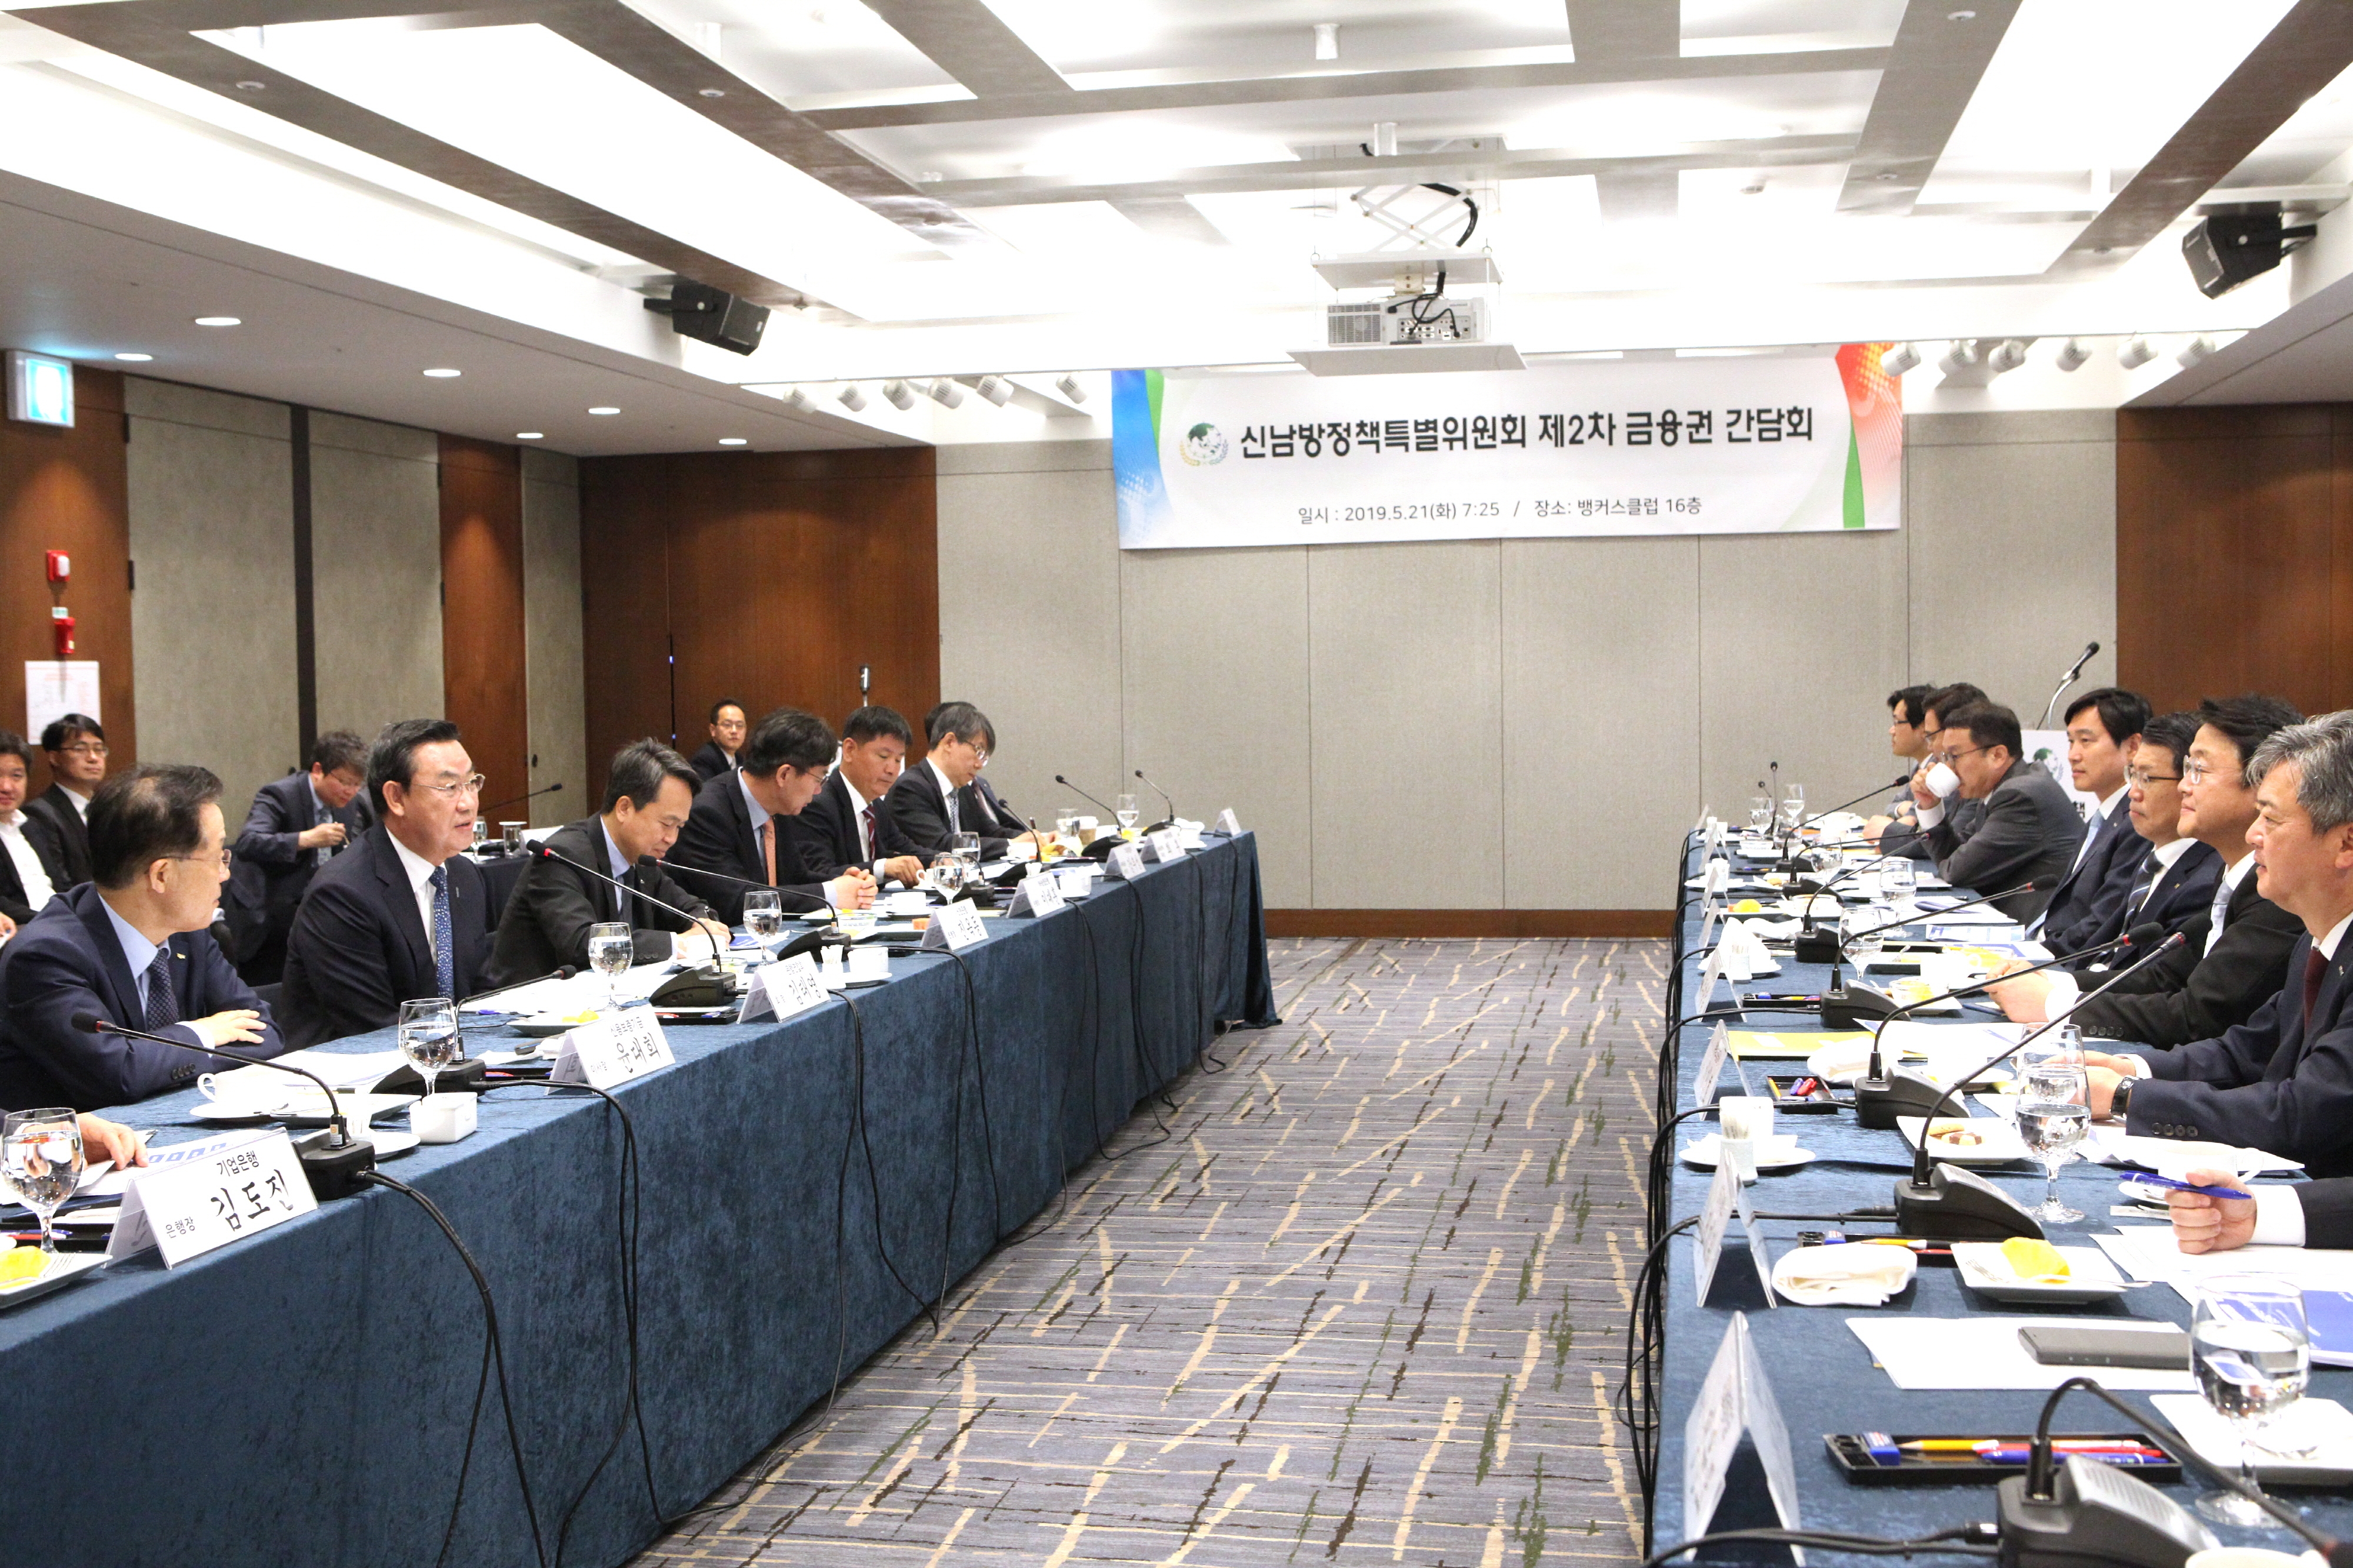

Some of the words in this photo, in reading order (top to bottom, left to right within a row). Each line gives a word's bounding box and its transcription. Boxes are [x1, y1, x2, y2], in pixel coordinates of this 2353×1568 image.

[1241, 413, 1527, 458] 신남방정책특별위원회
[1538, 411, 1616, 448] 제2차
[1626, 409, 1712, 446] 금융권
[1726, 406, 1812, 442] 간담회
[1298, 507, 1328, 525] 일시
[1345, 502, 1457, 521] 2019.5.21(화)
[1462, 502, 1499, 517] 7:25
[1534, 499, 1571, 517] 장소:
[1578, 497, 1658, 516] 뱅커스클럽
[1666, 496, 1702, 515] 16층
[788, 973, 821, 1005] 김태영
[610, 1016, 644, 1037] 신용보증기금
[616, 1032, 661, 1073] 윤대희
[590, 1061, 608, 1074] 이사장
[216, 1150, 259, 1177] 기업은행
[210, 1169, 294, 1232] 김도진
[165, 1216, 196, 1239] 은행장
